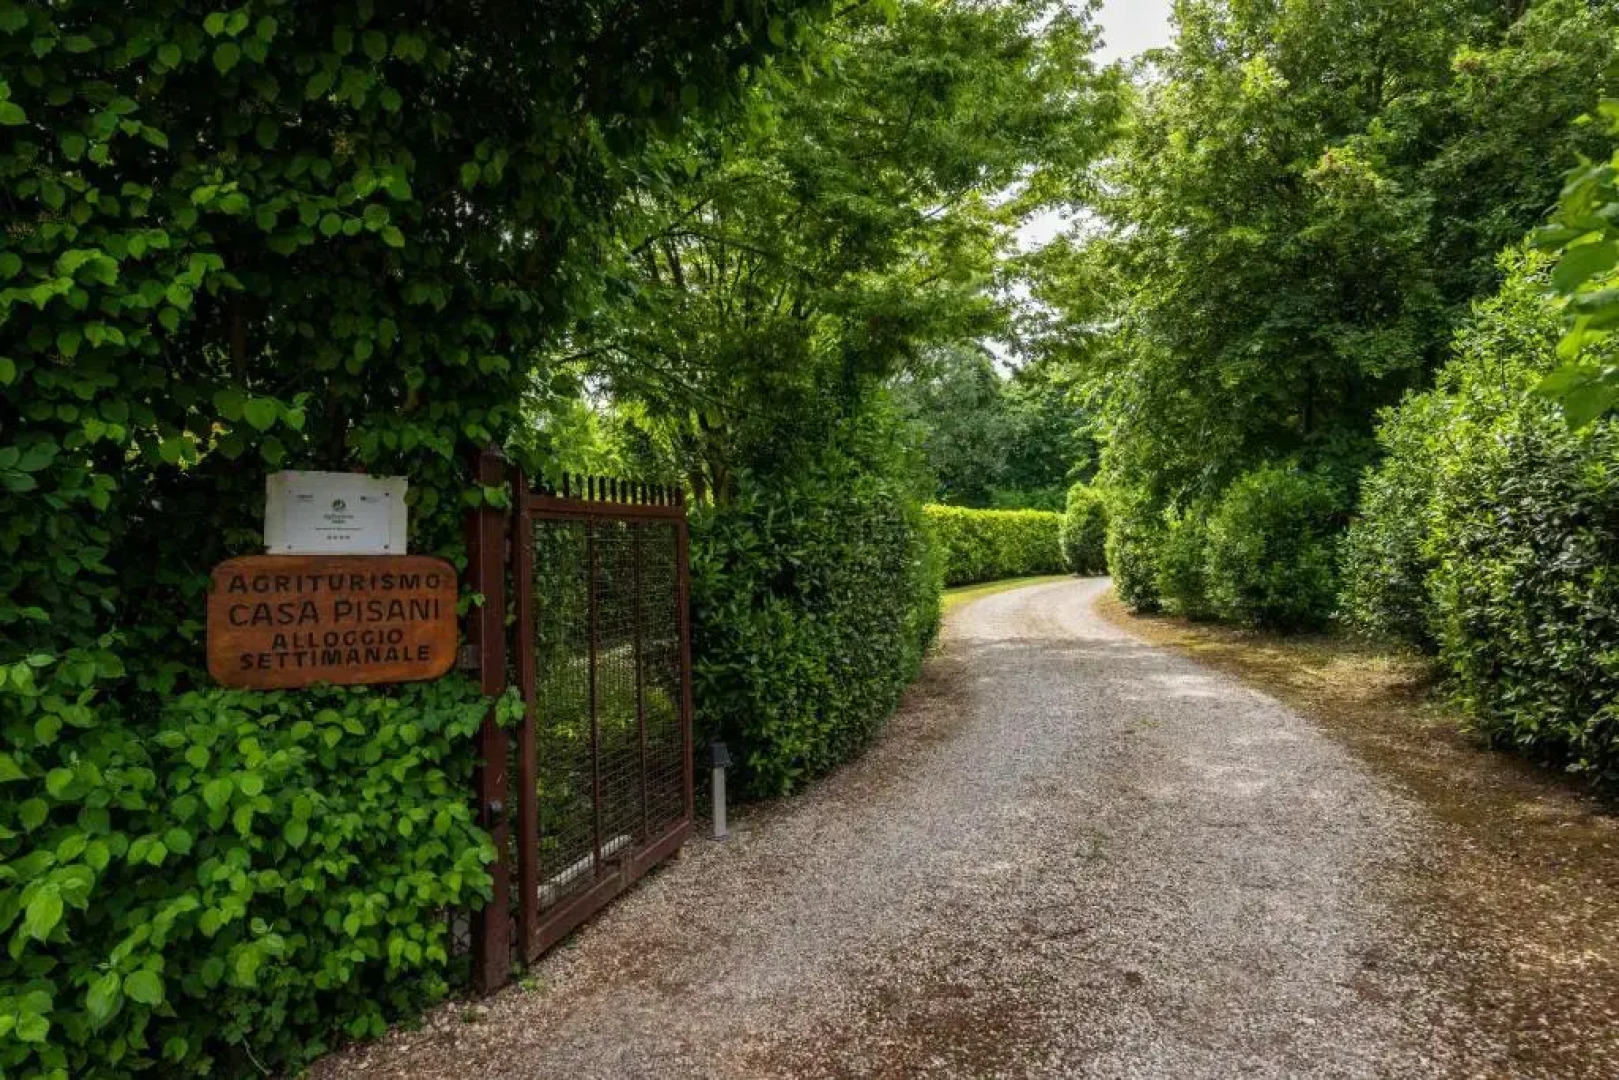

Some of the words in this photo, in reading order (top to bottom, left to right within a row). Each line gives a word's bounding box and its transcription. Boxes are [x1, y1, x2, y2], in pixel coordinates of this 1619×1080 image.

[228, 573, 441, 593] AGRITURISMO
[229, 600, 319, 626] CASA
[334, 598, 439, 623] PISANI
[272, 628, 404, 650] ALLOGGIO
[240, 645, 431, 669] SETTIMANALE
